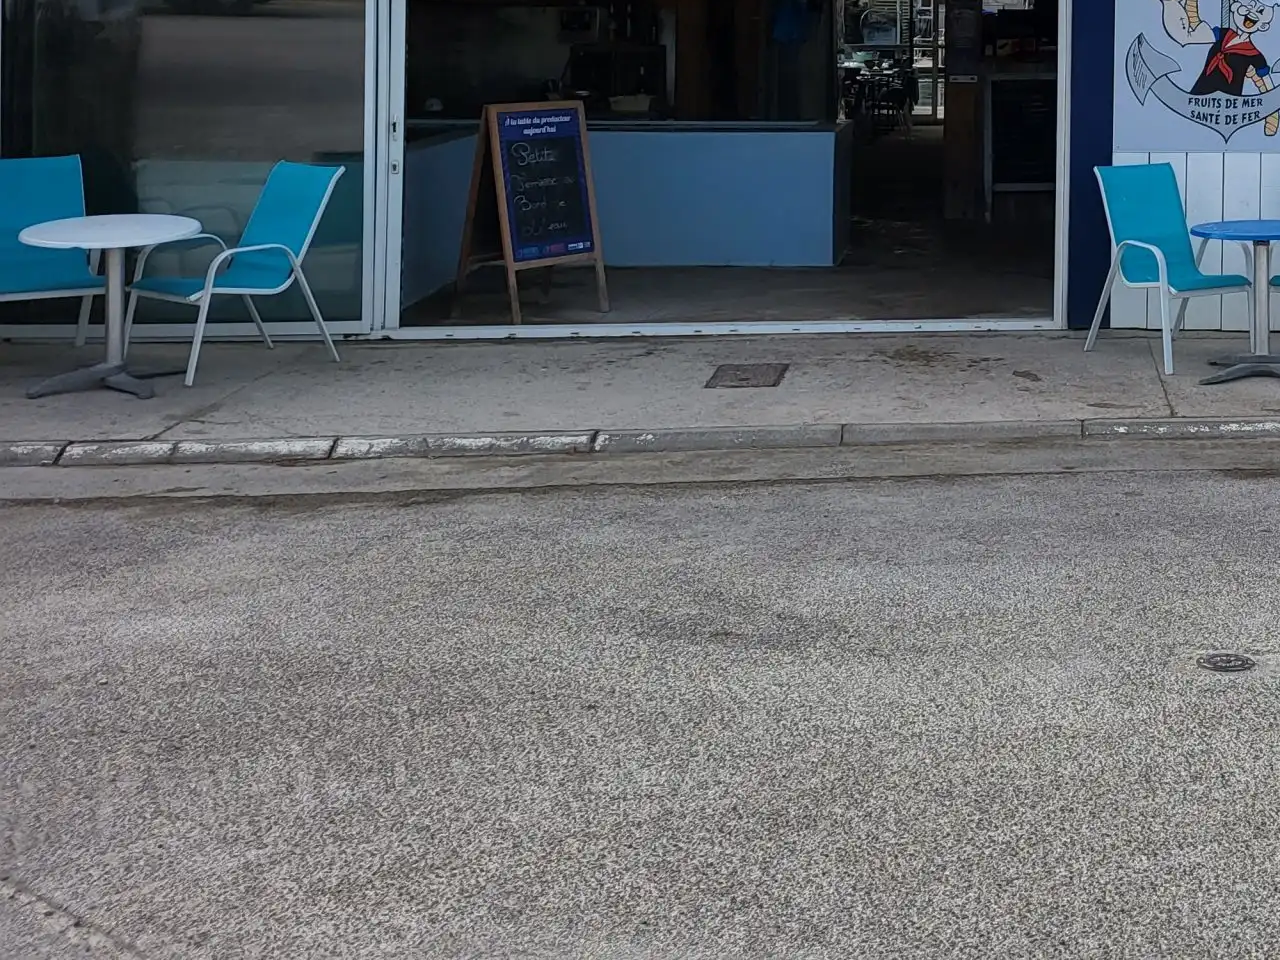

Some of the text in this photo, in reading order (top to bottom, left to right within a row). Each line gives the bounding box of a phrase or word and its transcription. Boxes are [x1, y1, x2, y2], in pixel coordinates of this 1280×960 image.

[1188, 97, 1263, 110] FRUITS DE MER
[541, 115, 571, 125] producteur
[1190, 109, 1261, 125] SANTÉ DE FER
